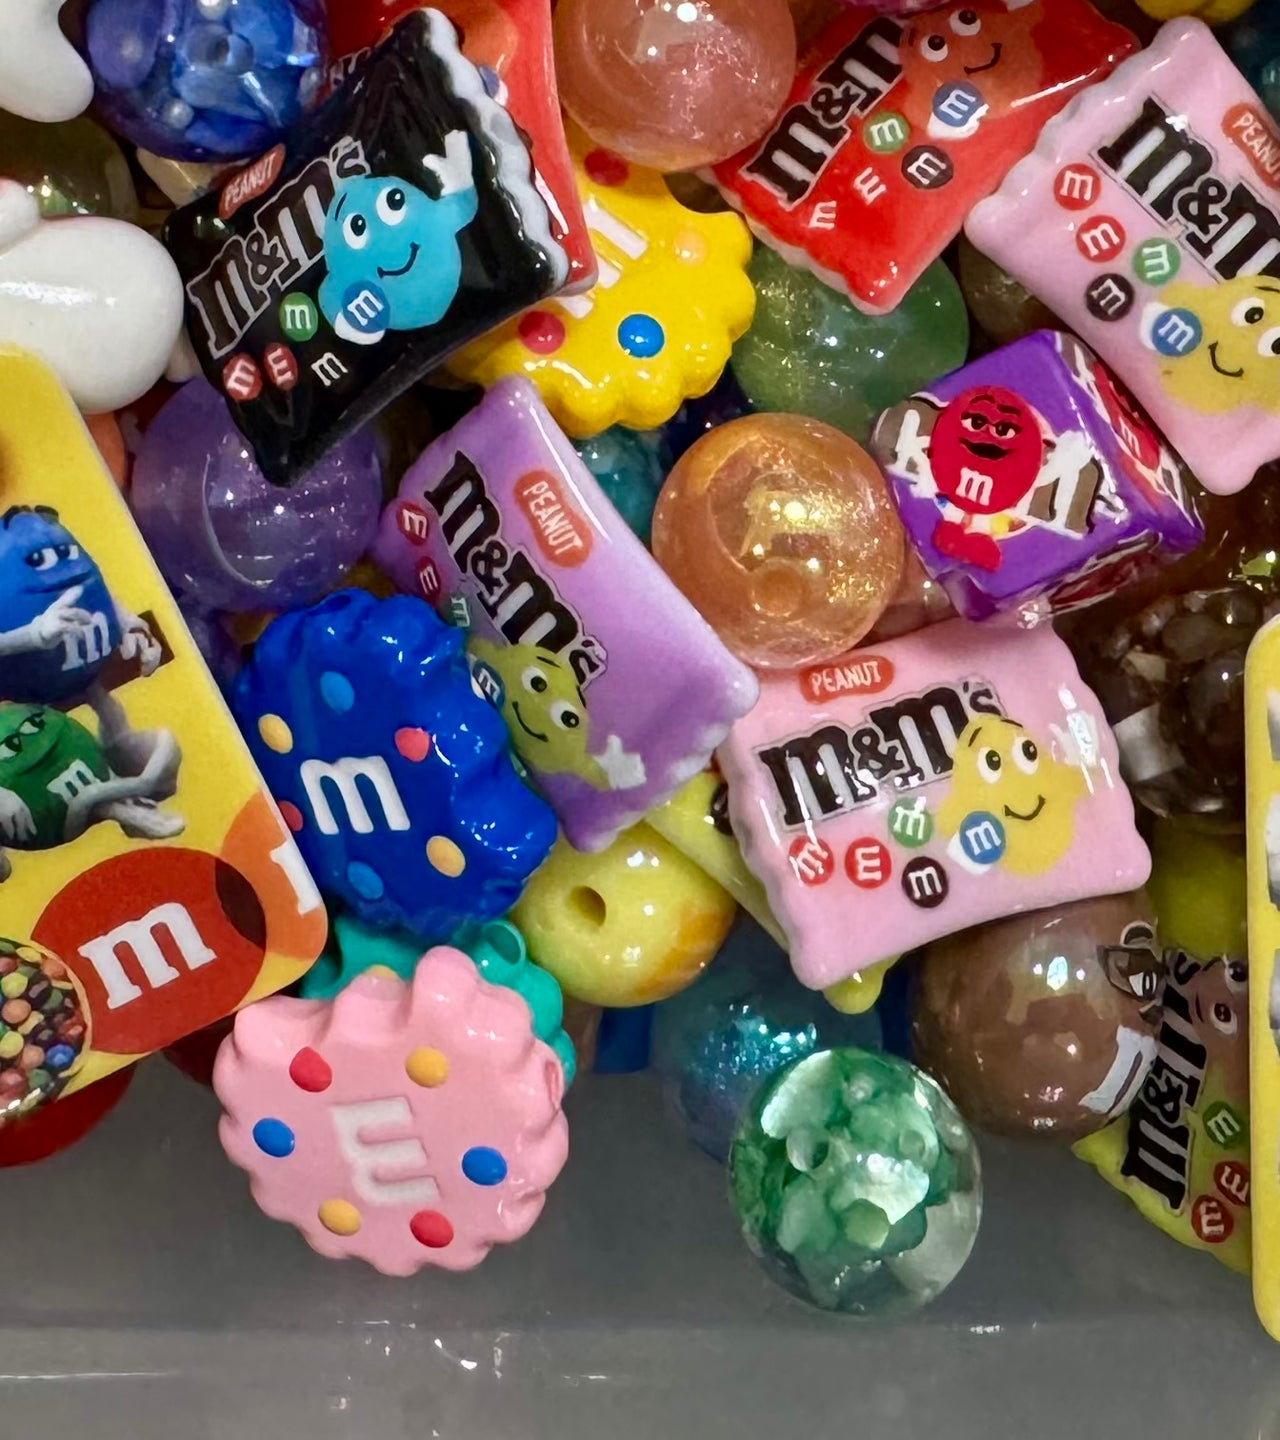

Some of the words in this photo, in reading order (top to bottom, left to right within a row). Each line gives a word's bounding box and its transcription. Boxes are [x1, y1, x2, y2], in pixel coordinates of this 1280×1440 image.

[940, 88, 976, 118] m
[871, 120, 903, 145] m
[224, 152, 278, 207] PEANUT
[854, 167, 887, 204] m
[908, 153, 947, 185] m
[1060, 174, 1093, 200] m
[809, 200, 837, 230] m
[1081, 224, 1119, 255] m
[1142, 245, 1170, 277] m
[348, 288, 384, 327] m
[1092, 278, 1128, 316] m
[285, 303, 312, 330] m
[1159, 314, 1194, 351] m
[227, 360, 257, 394] m
[266, 349, 296, 381] m
[312, 351, 349, 386] m
[956, 468, 993, 505] m
[403, 510, 428, 538] m
[524, 481, 583, 557] PEANUT
[420, 567, 439, 593] m
[424, 451, 607, 689] m&m's
[452, 597, 469, 627] m
[61, 612, 112, 671] m
[810, 663, 881, 693] PEANUT
[759, 682, 1000, 826] m&m's
[46, 759, 110, 803] m
[300, 755, 411, 835] m
[892, 806, 925, 839] m
[965, 822, 999, 854] m
[855, 846, 883, 880] m
[908, 865, 941, 896] m
[78, 902, 216, 1009] m
[1208, 1111, 1240, 1139] m
[332, 1097, 441, 1205] m
[1220, 1165, 1248, 1200] m
[1198, 1205, 1225, 1237] m
